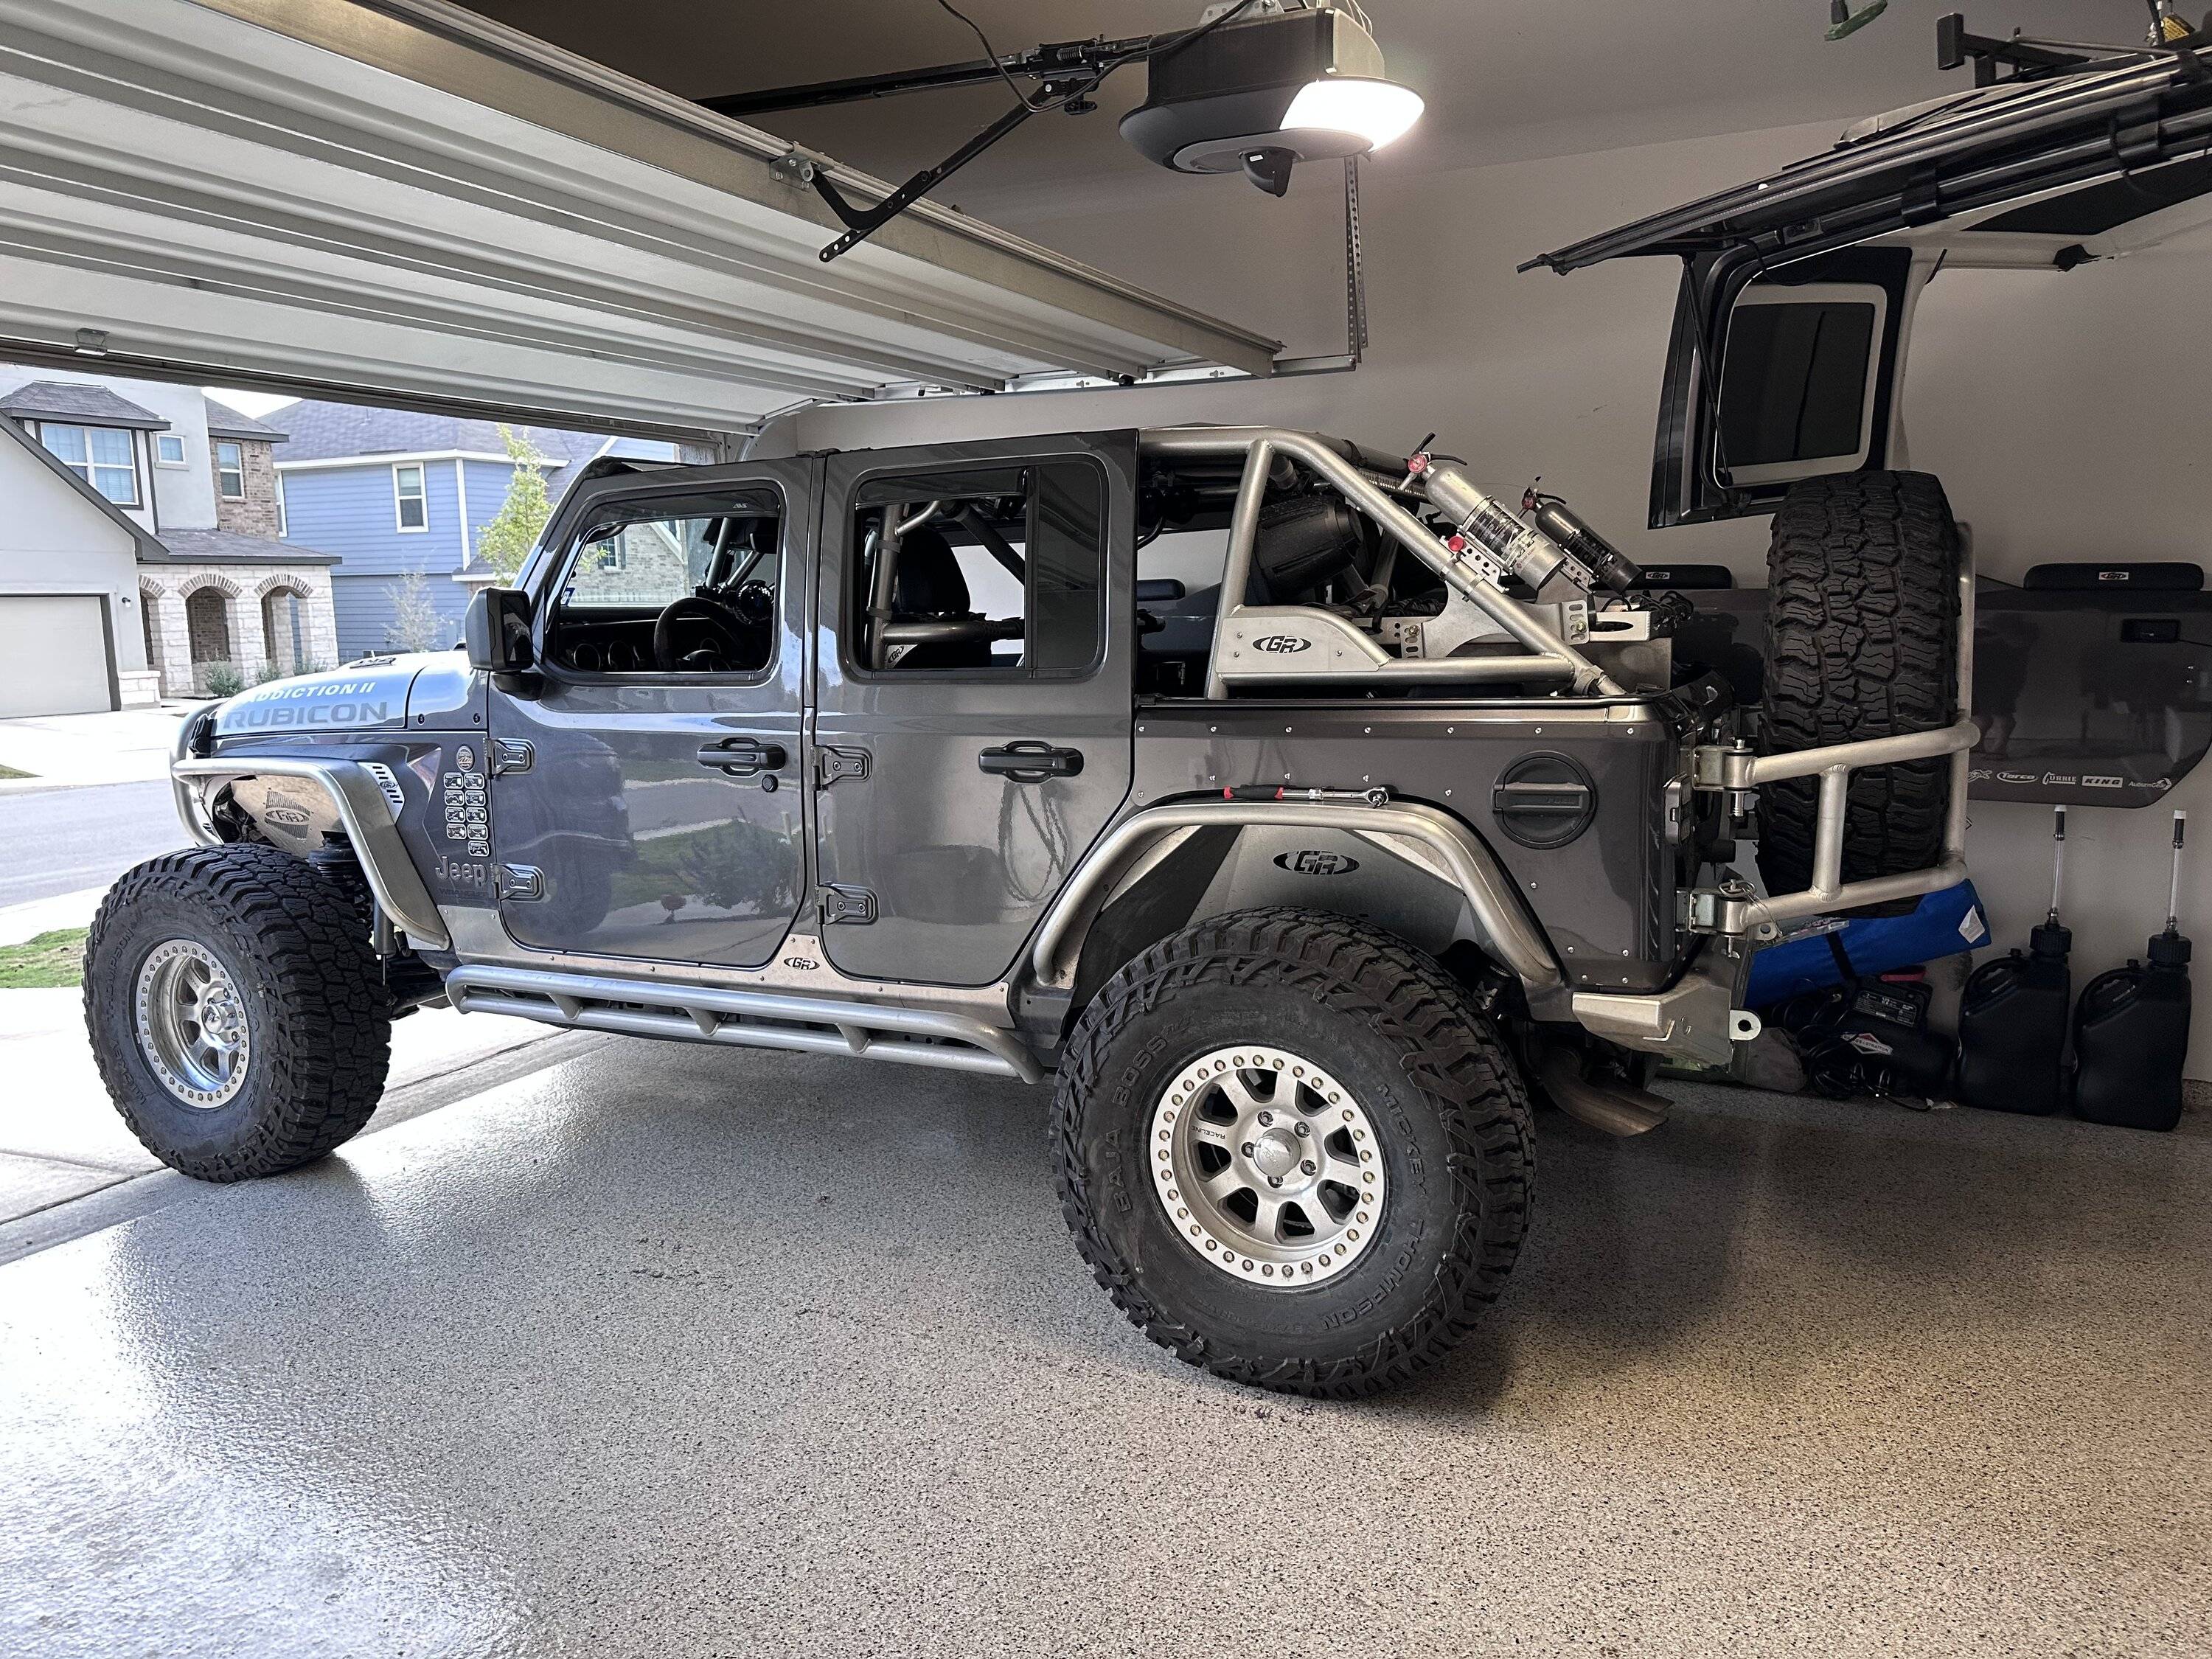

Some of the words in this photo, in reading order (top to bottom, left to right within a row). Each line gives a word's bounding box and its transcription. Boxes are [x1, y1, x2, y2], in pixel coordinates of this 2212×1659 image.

[223, 701, 388, 728] RUBICON
[435, 855, 487, 887] Jeep
[1111, 1034, 1167, 1107] BOSS
[1191, 1125, 1225, 1140] RACELINE
[1376, 1083, 1427, 1198] MICKEY
[1105, 1127, 1133, 1214] BAJA
[1321, 1218, 1425, 1329] THOMPSON
